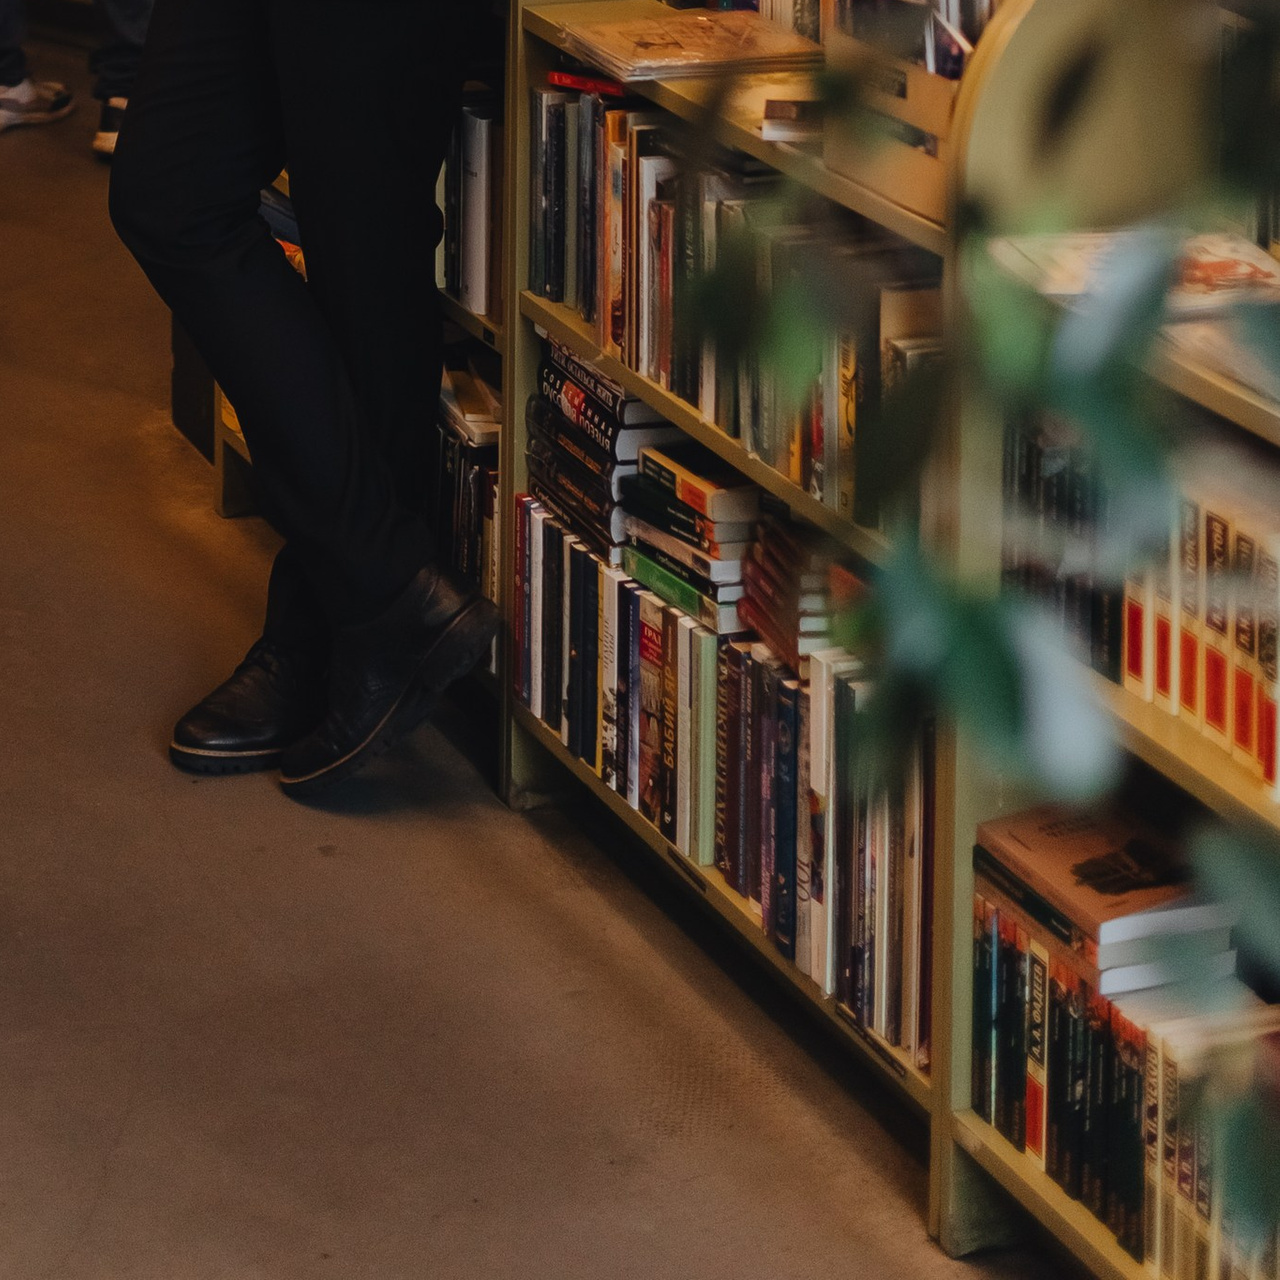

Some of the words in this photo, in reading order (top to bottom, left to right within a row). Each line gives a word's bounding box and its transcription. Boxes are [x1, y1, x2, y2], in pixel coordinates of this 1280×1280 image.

[665, 666, 677, 696] ЯР
[662, 696, 677, 770] БАБИЙ
[1029, 963, 1043, 1027] ФАДЕЕВ
